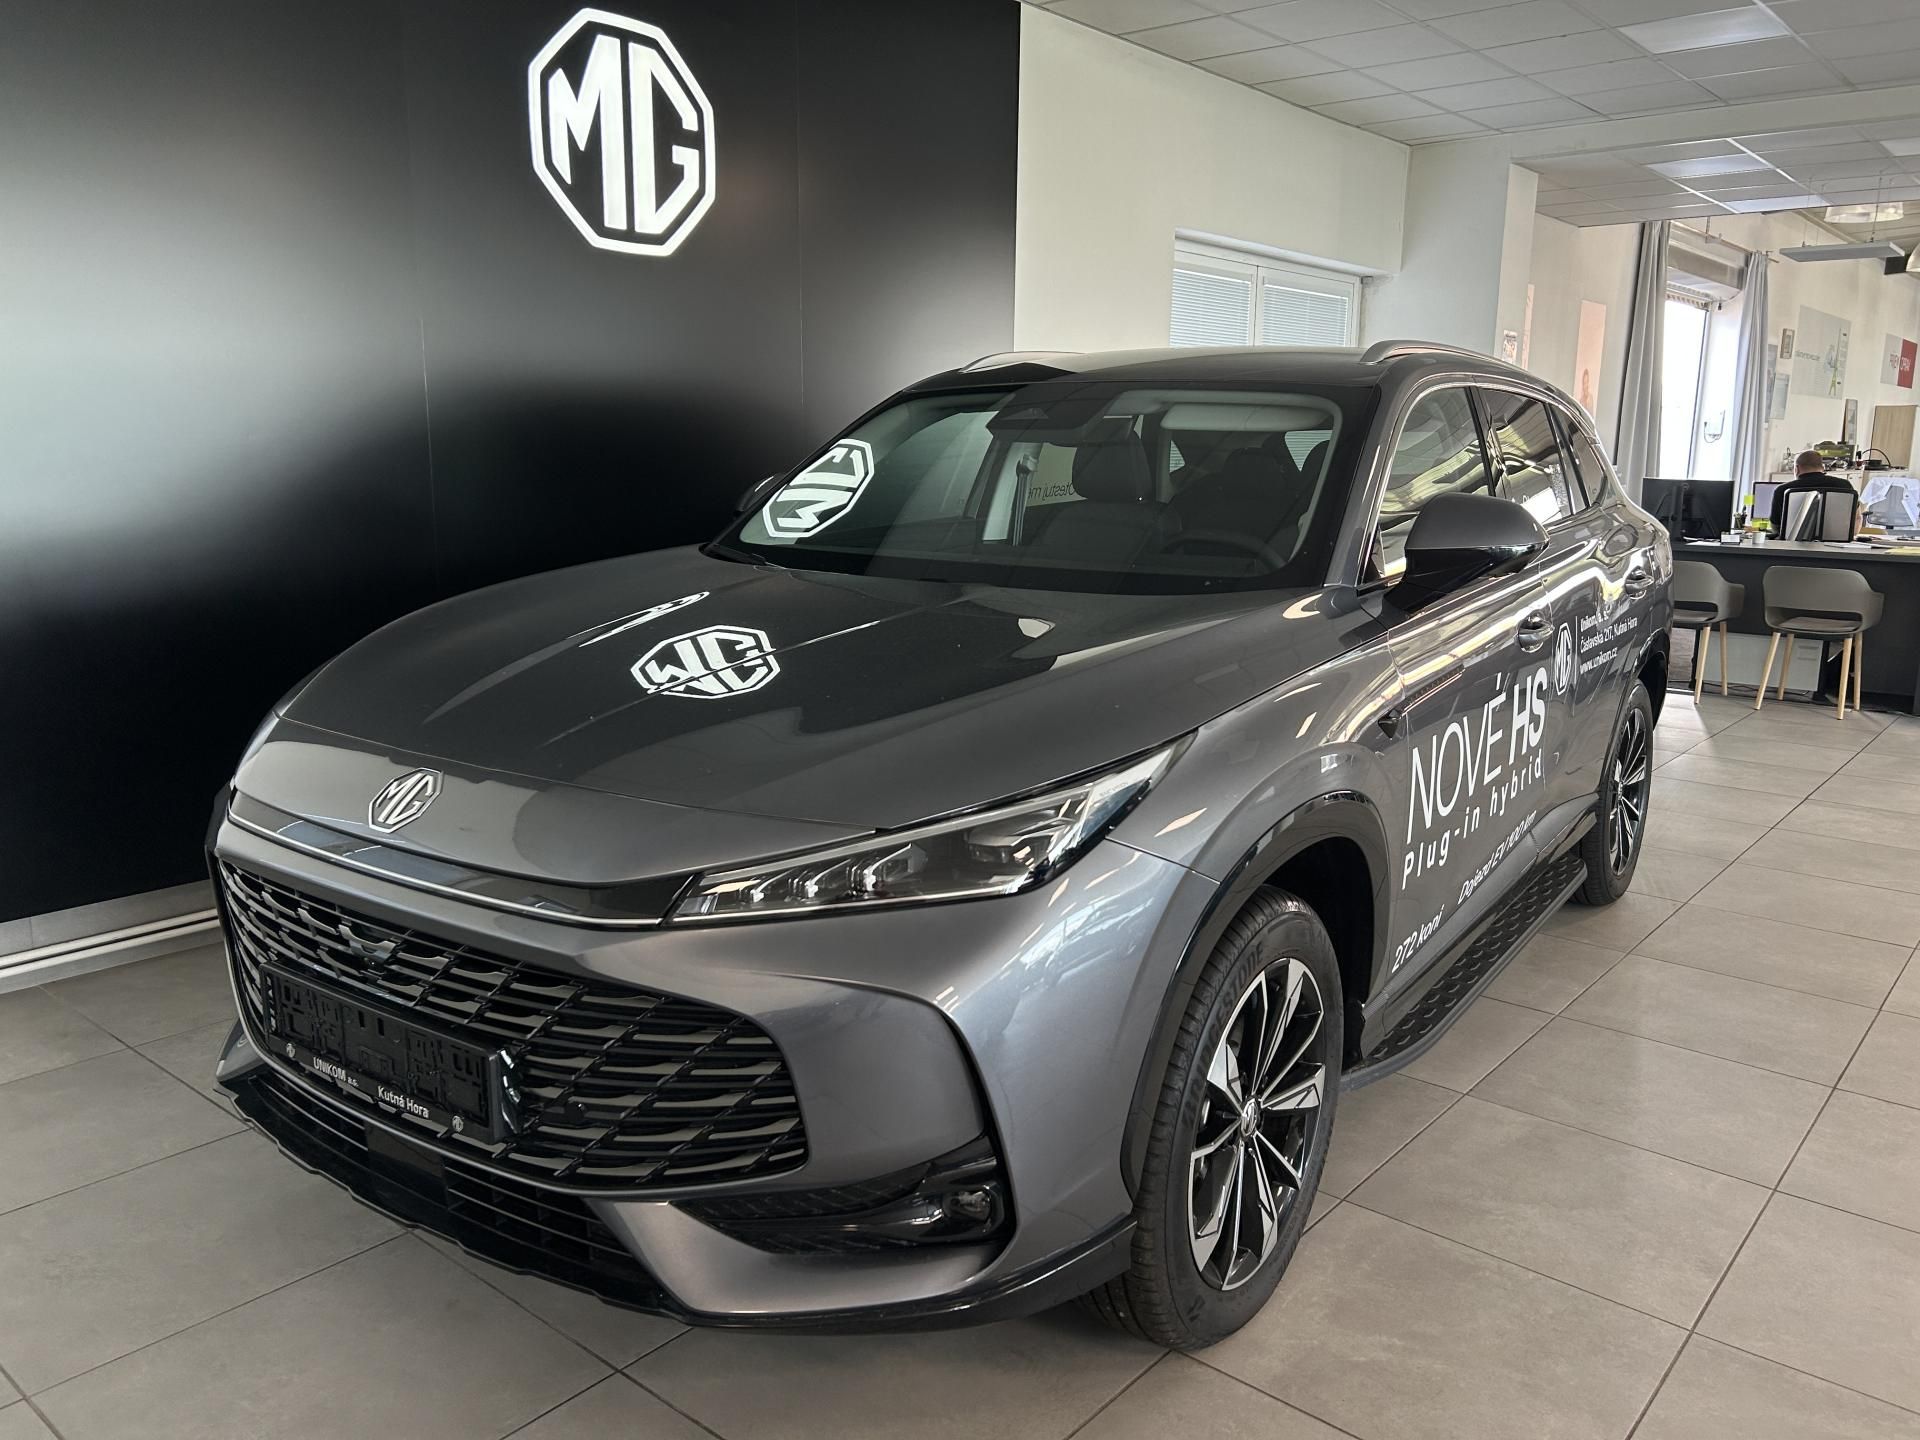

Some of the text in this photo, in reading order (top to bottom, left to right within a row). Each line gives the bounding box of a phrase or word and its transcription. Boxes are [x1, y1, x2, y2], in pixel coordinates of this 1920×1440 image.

[547, 34, 700, 235] MG
[1555, 629, 1571, 689] MG
[1407, 667, 1547, 845] NOVÉ HS
[374, 771, 437, 826] MG
[1402, 748, 1541, 890] Plug-in hybrid
[1391, 931, 1417, 974] 272
[313, 1056, 347, 1082] UNIKOM
[377, 1085, 429, 1118] Kutná Hora
